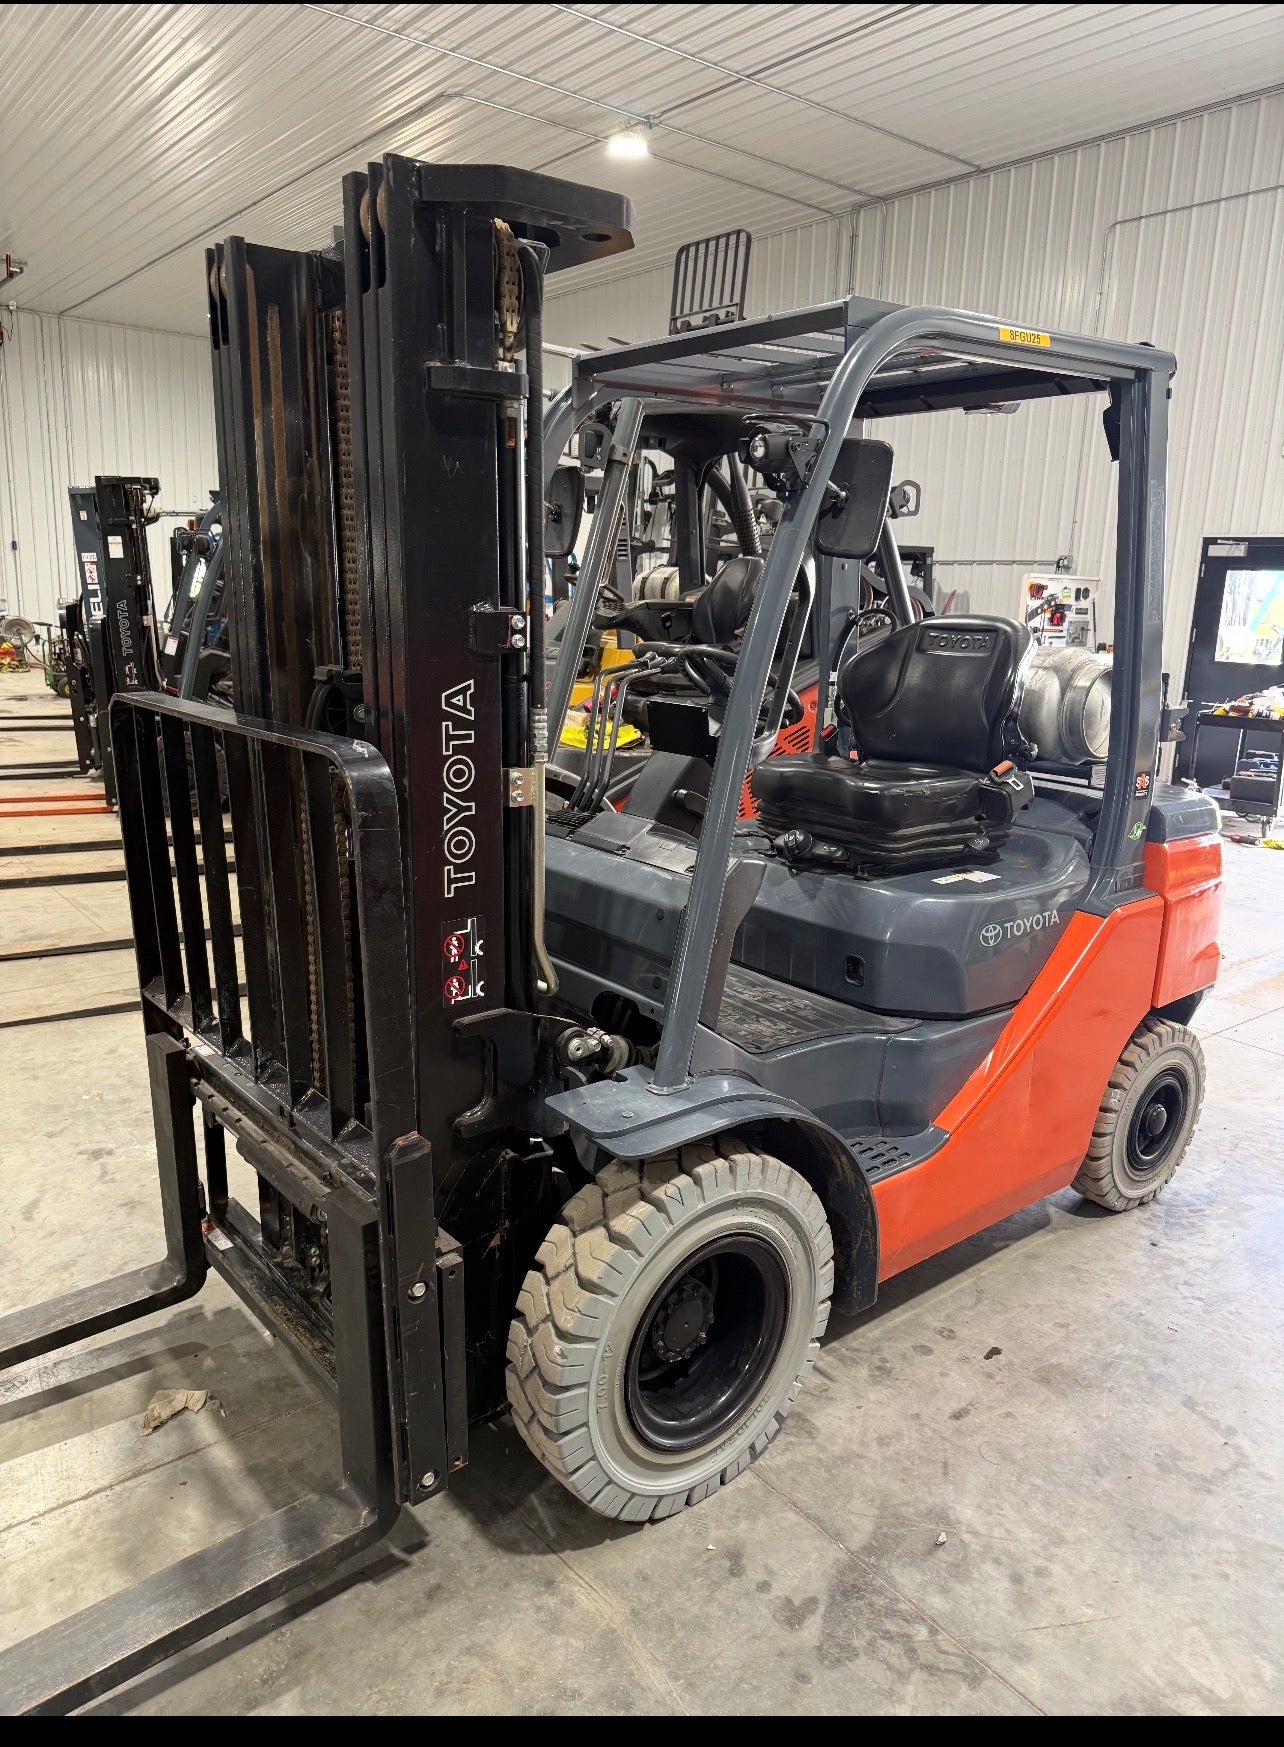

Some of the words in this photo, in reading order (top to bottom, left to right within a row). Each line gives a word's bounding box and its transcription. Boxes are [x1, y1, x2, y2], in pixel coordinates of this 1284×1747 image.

[1010, 330, 1041, 344] 8FGU25
[88, 584, 103, 615] ELI
[116, 600, 134, 656] TOYOTA
[929, 633, 990, 649] TOYOTA
[441, 679, 476, 898] TOYOTA
[1004, 909, 1060, 939] TOYOTA
